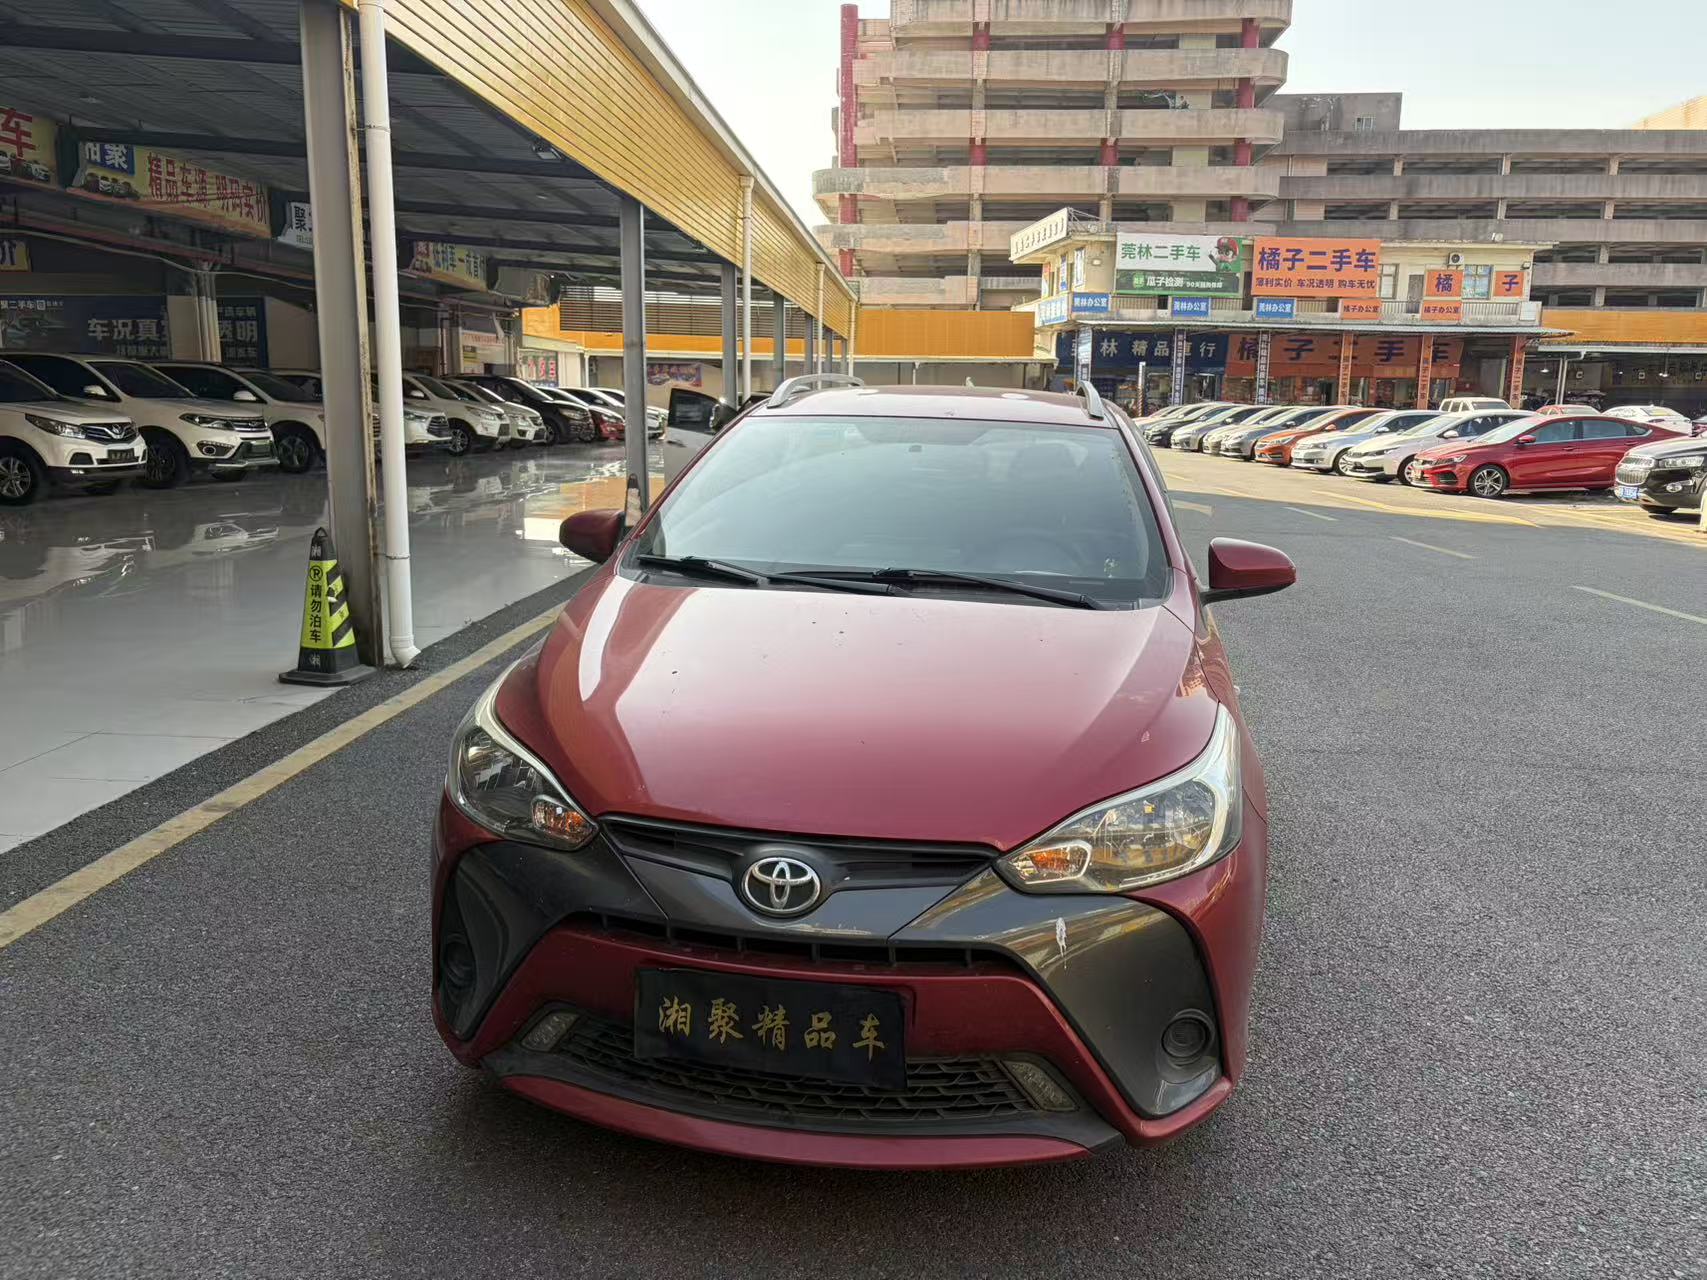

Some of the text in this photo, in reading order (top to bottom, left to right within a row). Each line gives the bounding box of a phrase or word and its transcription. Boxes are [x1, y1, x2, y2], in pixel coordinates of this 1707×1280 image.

[1121, 243, 1201, 261] 莞林二手车
[1258, 247, 1376, 272] 橘子二手车
[1255, 278, 1376, 289] 薄利实价 车况透明 购车无忧
[1435, 274, 1519, 292] 橘 子
[310, 584, 322, 643] 请勿泊车
[658, 996, 886, 1062] 湘聚精品车
